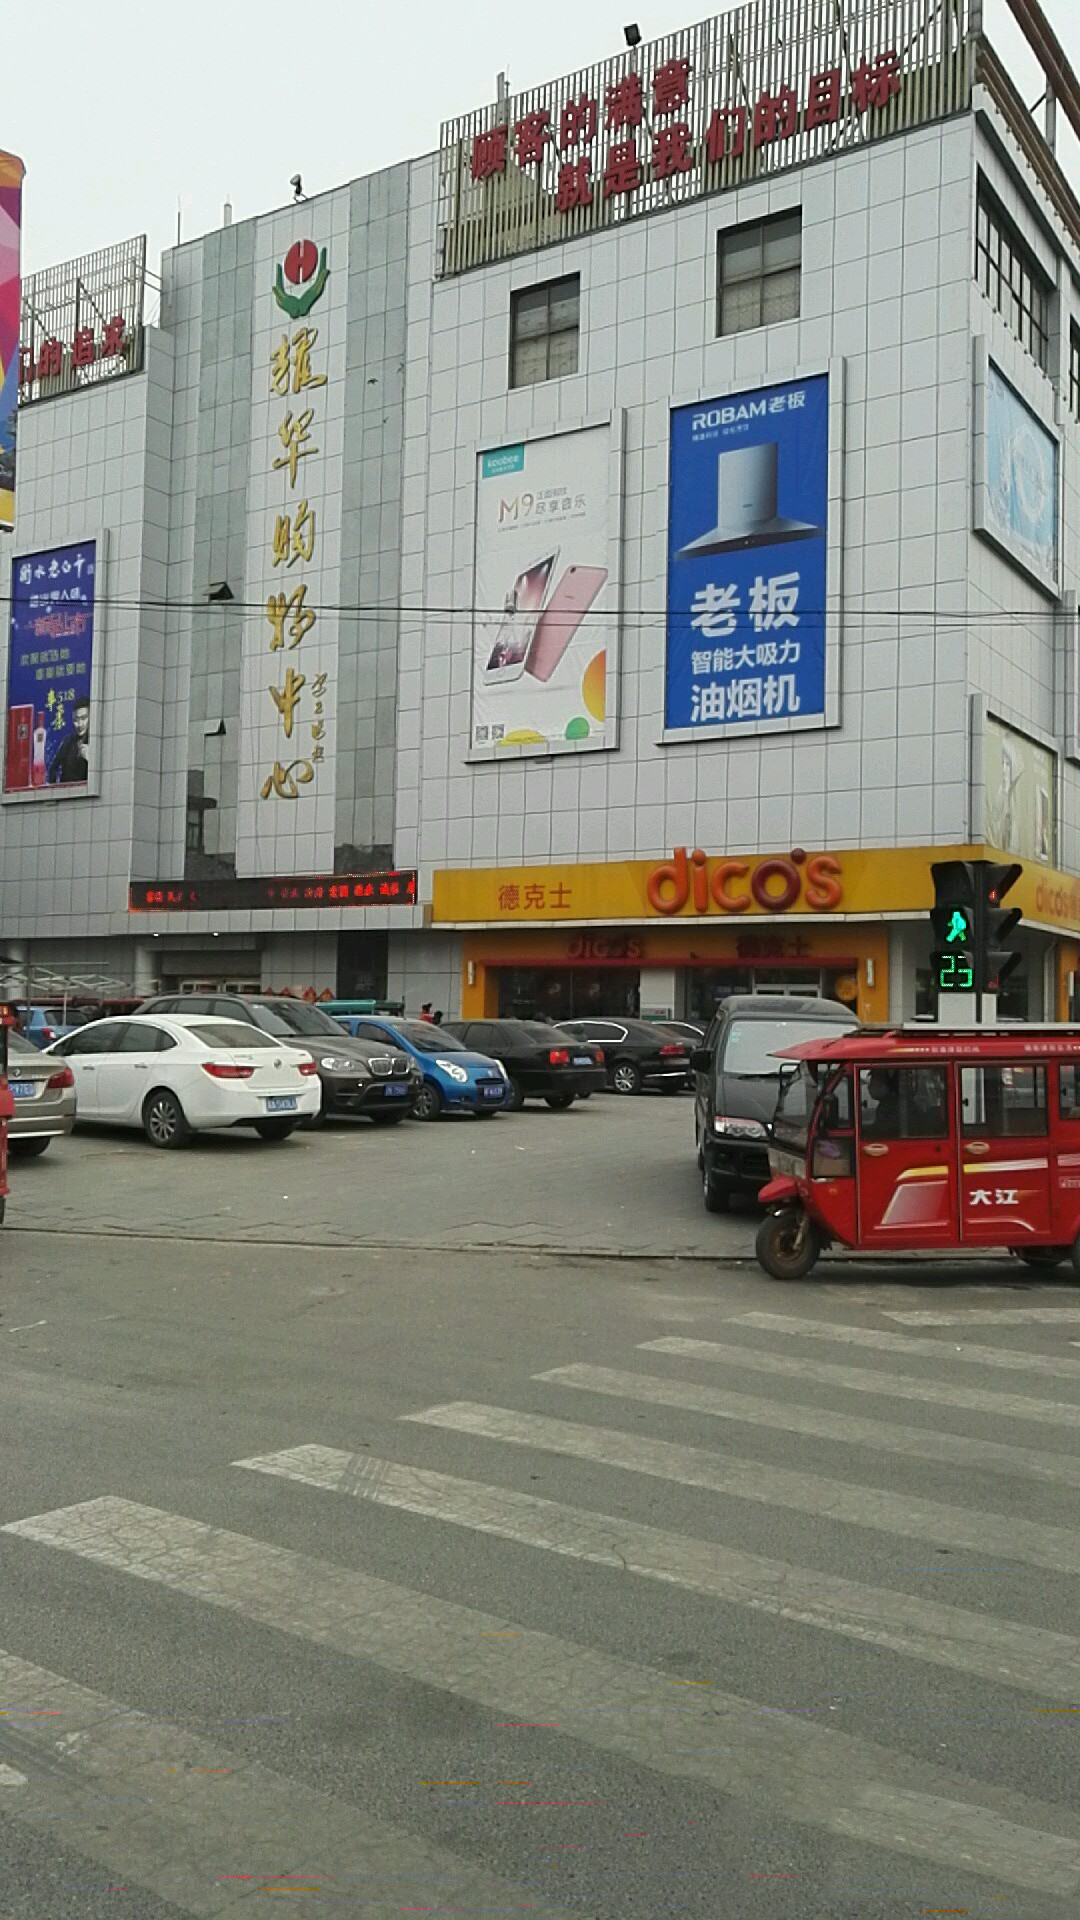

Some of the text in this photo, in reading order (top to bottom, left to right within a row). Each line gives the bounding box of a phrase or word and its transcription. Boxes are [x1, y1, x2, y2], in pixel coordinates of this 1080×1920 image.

[472, 58, 693, 180] 顾客的满意
[554, 50, 902, 213] 就是我们的目标
[498, 493, 535, 523] M9
[259, 327, 328, 800] 耀华购物中心
[690, 572, 800, 637] 老板
[691, 640, 800, 675] 智能大吸力
[691, 674, 800, 722] 油烟机
[498, 882, 573, 910] 德克士
[969, 1189, 1018, 1205] 大江
